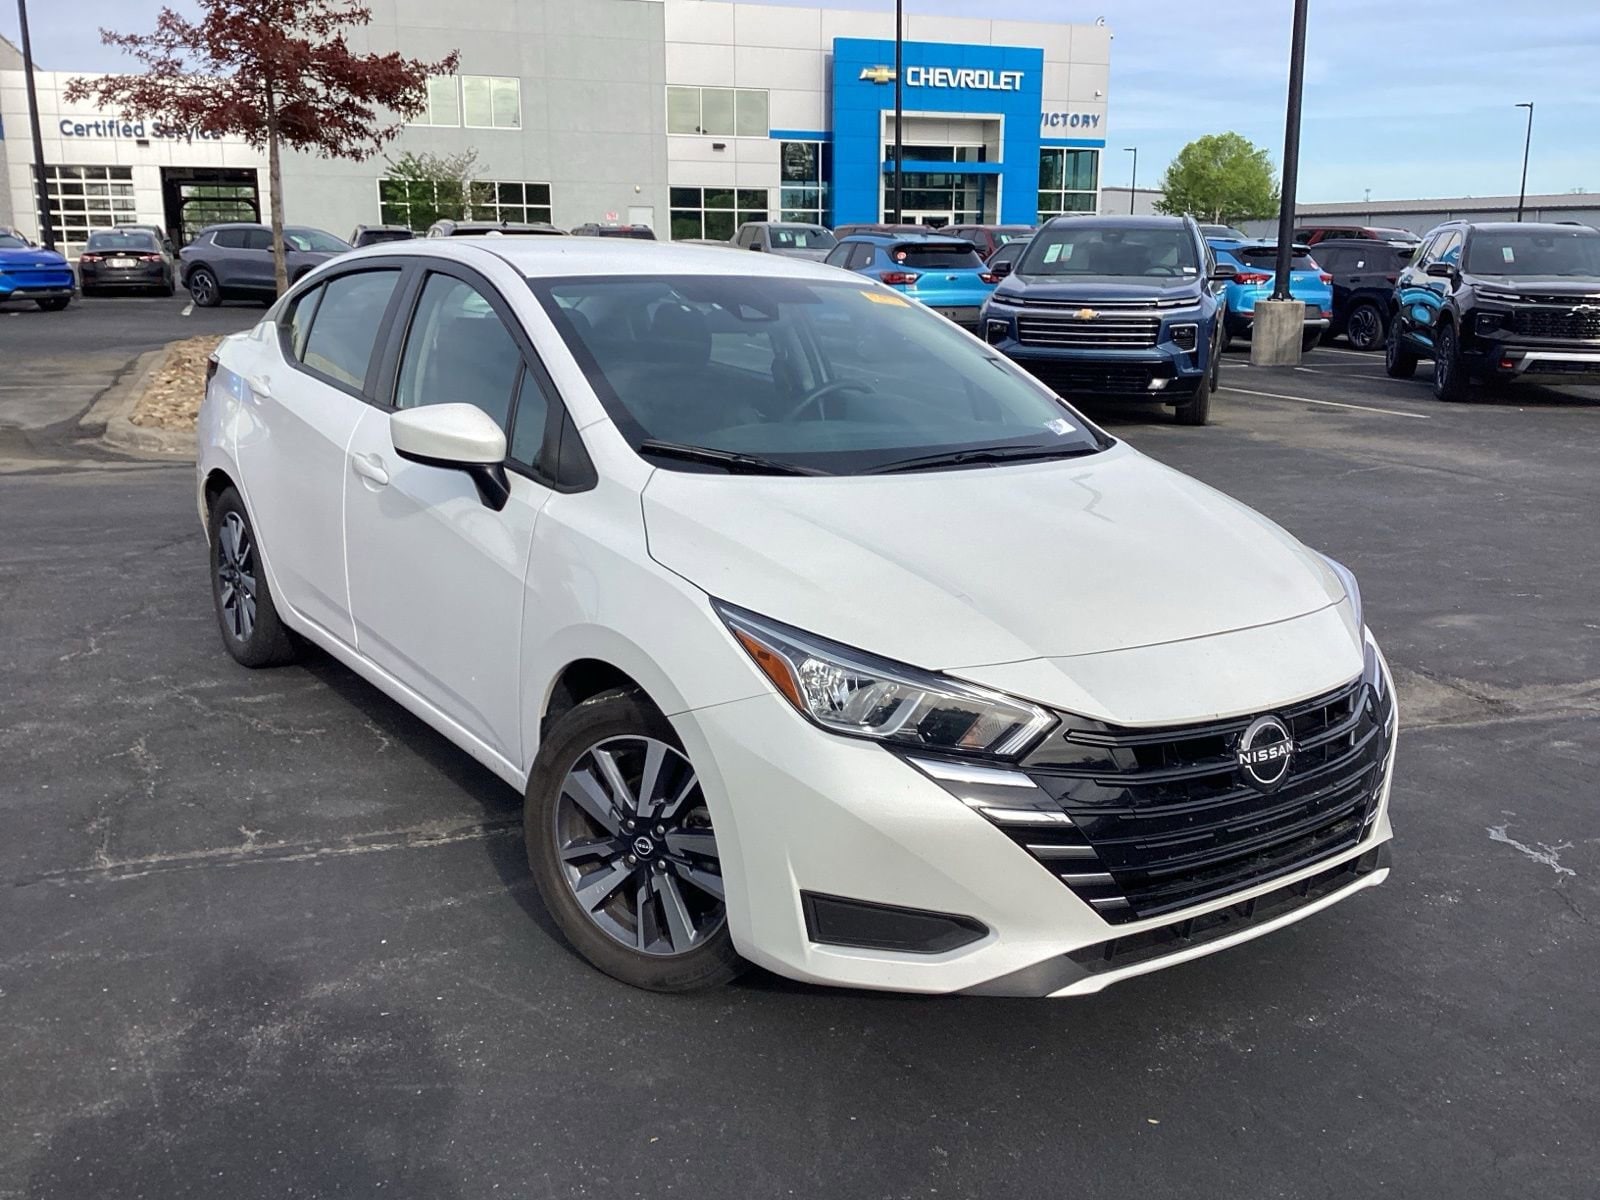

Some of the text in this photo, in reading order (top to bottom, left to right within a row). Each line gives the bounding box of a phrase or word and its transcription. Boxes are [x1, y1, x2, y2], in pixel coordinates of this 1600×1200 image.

[906, 66, 1025, 91] CHEVROLET
[59, 119, 221, 140] Certified Sevice
[1239, 740, 1294, 765] NISSAN
